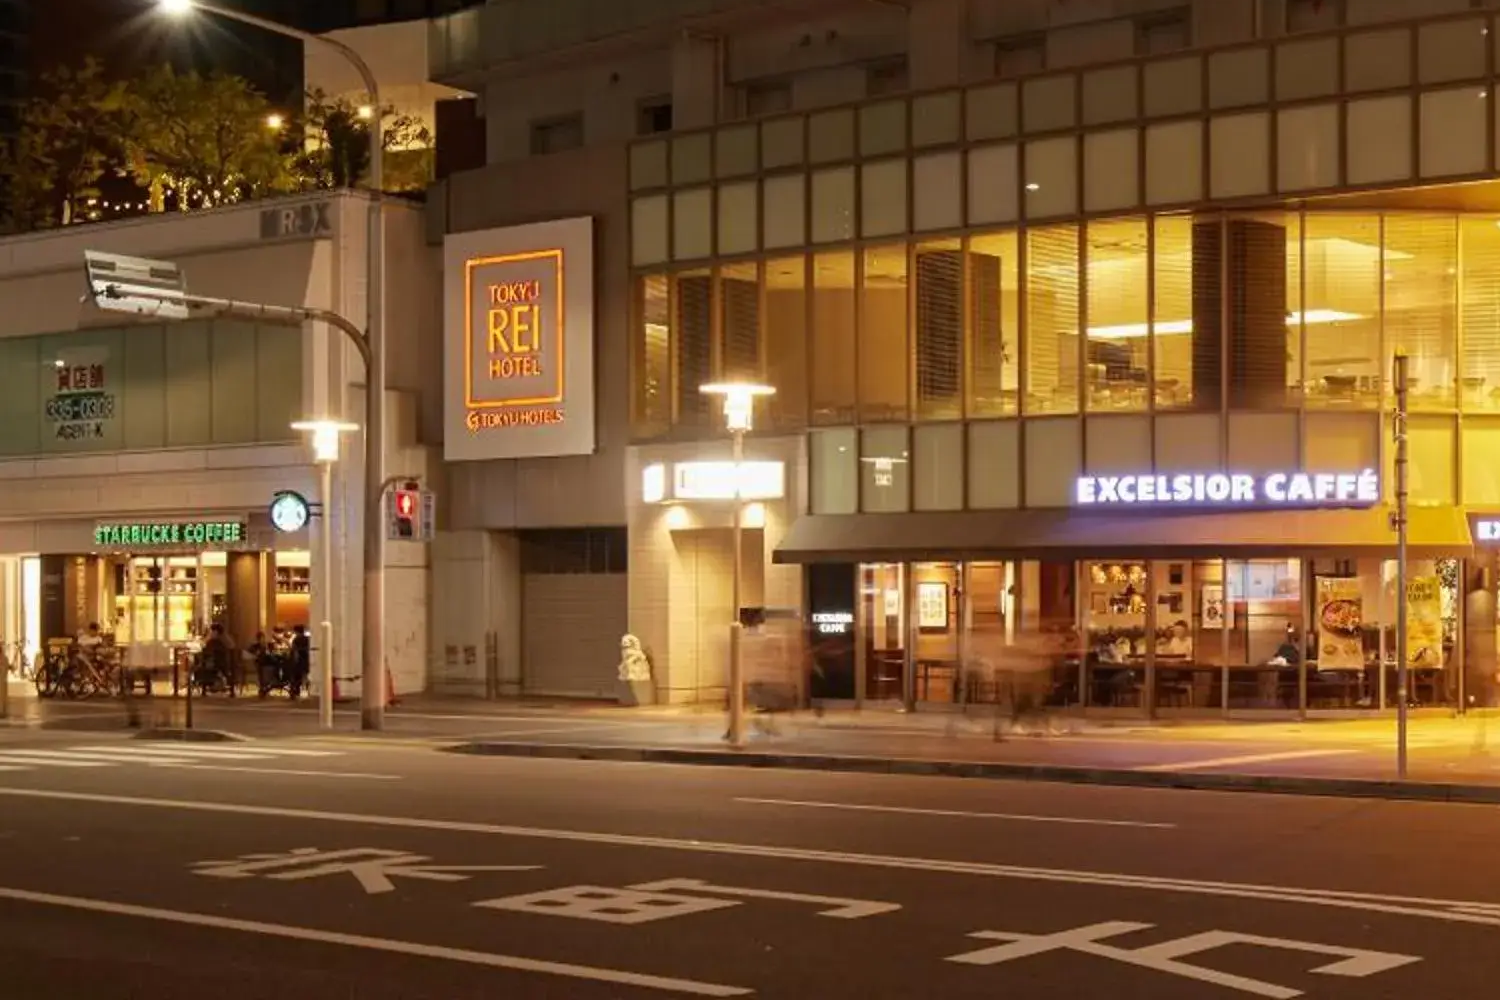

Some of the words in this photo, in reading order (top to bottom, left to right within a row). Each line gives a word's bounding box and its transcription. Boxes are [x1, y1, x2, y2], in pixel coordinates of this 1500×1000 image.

[489, 281, 539, 303] TOKYU
[488, 305, 540, 353] REI
[489, 356, 541, 380] HOTEL
[482, 412, 519, 428] TOKYU
[520, 409, 565, 426] HOTELS
[1077, 474, 1255, 502] EXCELSIOR
[1264, 469, 1379, 501] CAFFÉ
[95, 525, 180, 545] STARBUCKS
[184, 522, 241, 544] COFFEE
